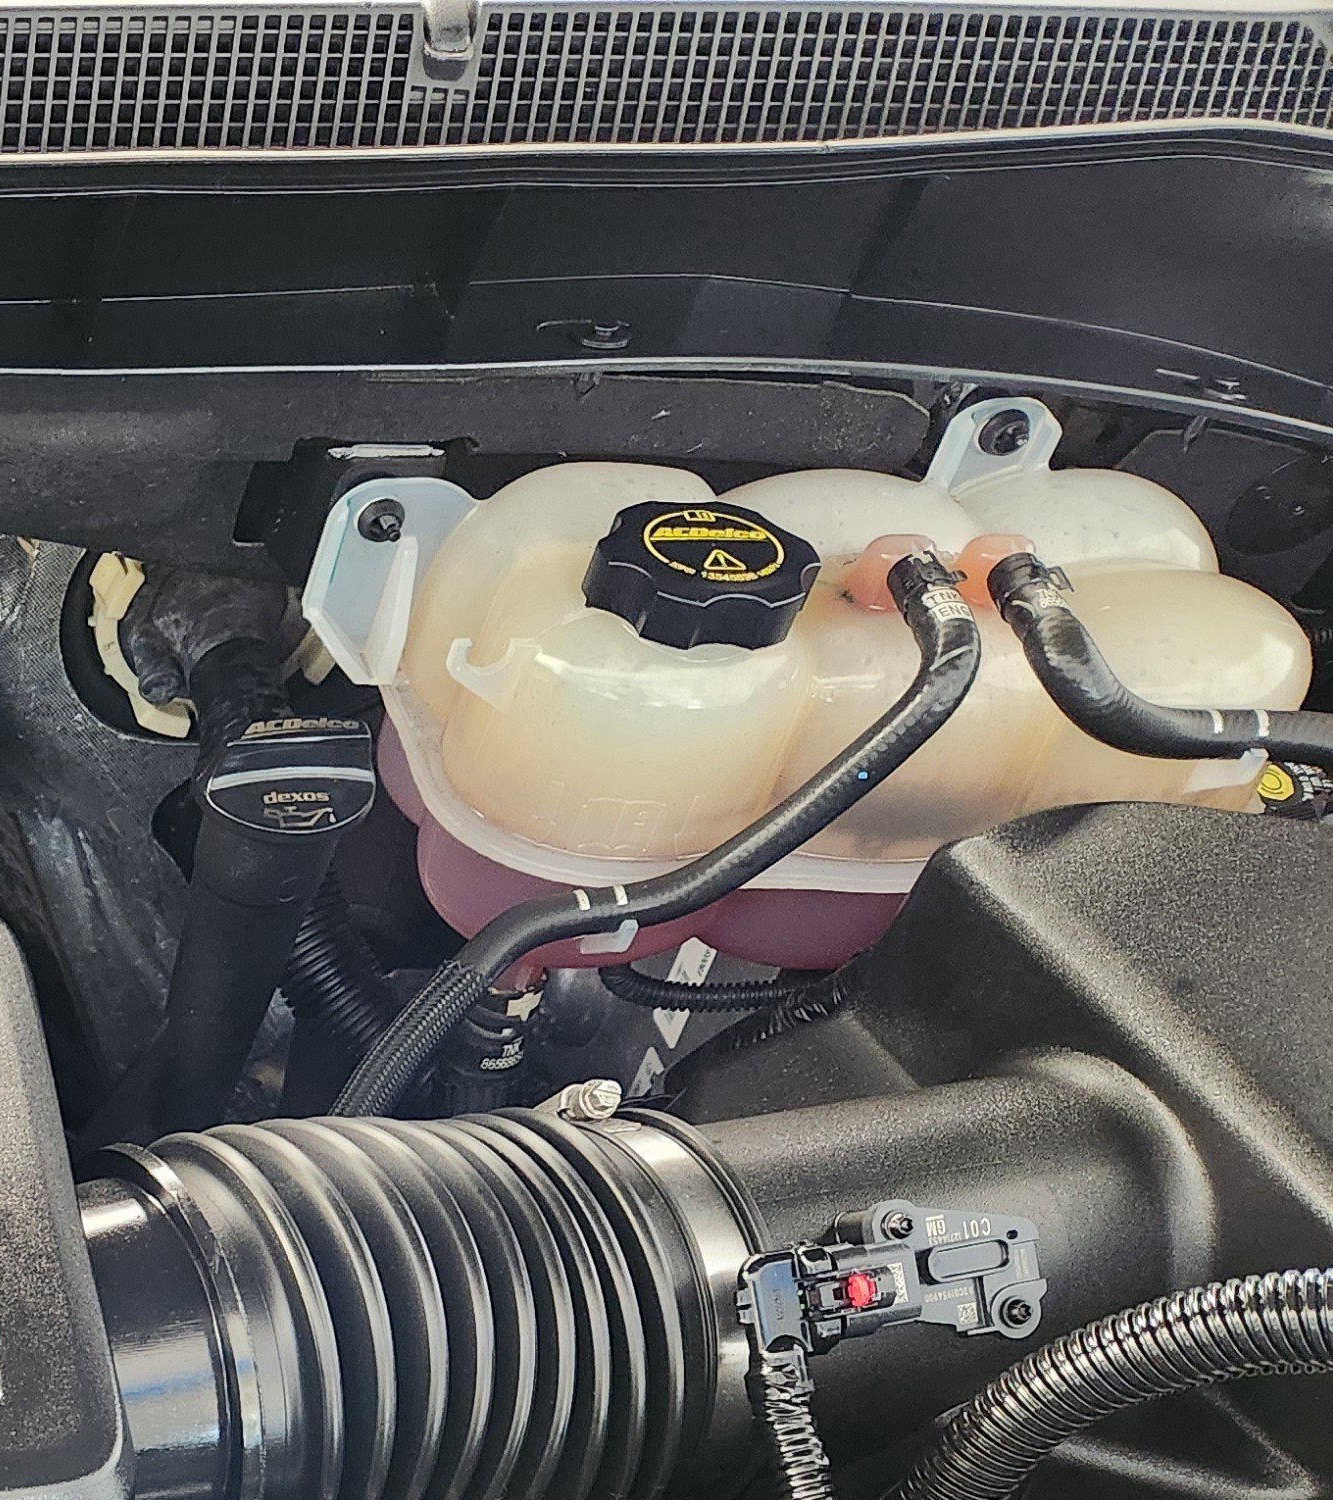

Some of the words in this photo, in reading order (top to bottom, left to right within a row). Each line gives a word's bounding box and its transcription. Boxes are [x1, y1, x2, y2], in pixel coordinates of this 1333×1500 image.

[652, 527, 768, 540] ACDelco
[244, 718, 360, 735] ACDelco
[263, 791, 330, 804] dexos
[925, 1217, 946, 1238] GM
